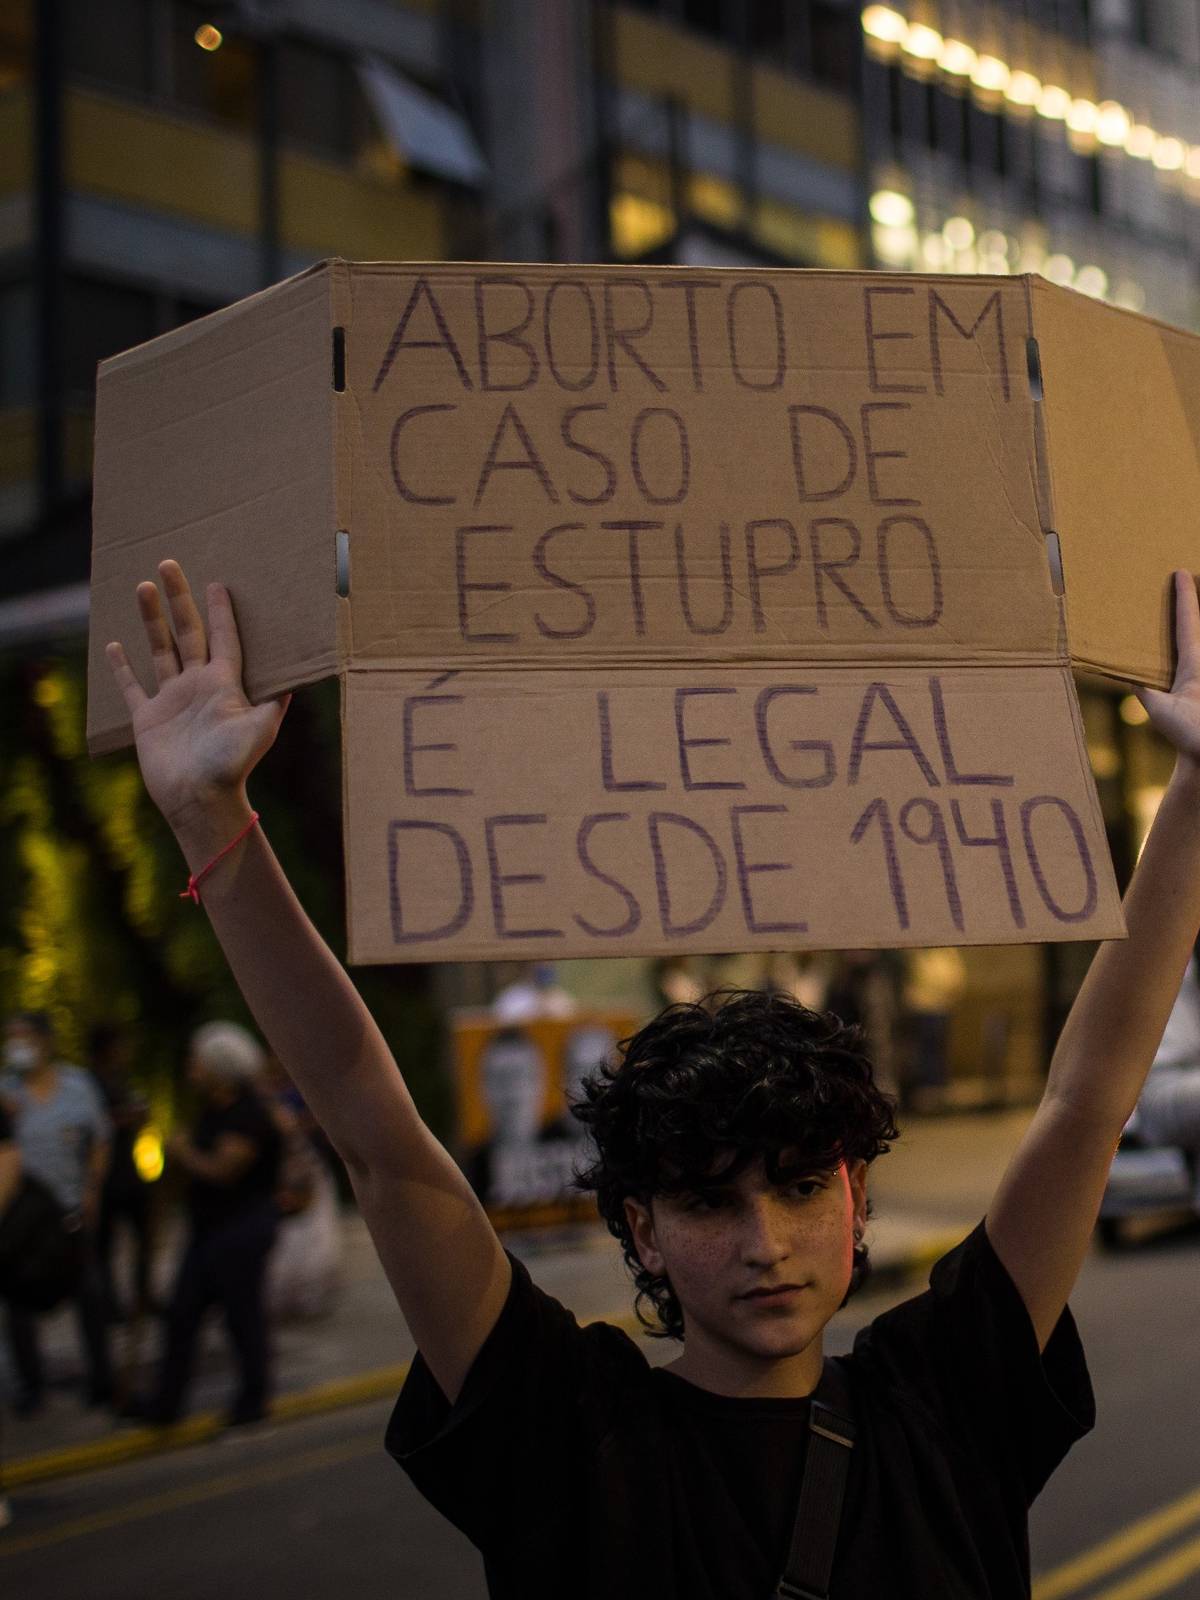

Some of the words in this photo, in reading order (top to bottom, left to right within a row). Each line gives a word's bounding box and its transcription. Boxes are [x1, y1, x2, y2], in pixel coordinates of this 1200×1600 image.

[373, 276, 788, 393] ABORTO
[864, 286, 1010, 402] EM
[390, 402, 691, 508] CASO
[788, 403, 921, 506] DE
[455, 515, 945, 644] ESTUPRO
[402, 671, 473, 797] É
[599, 677, 1015, 792] LEGAL
[388, 804, 808, 945] DESDE
[850, 796, 1098, 933] 1940
